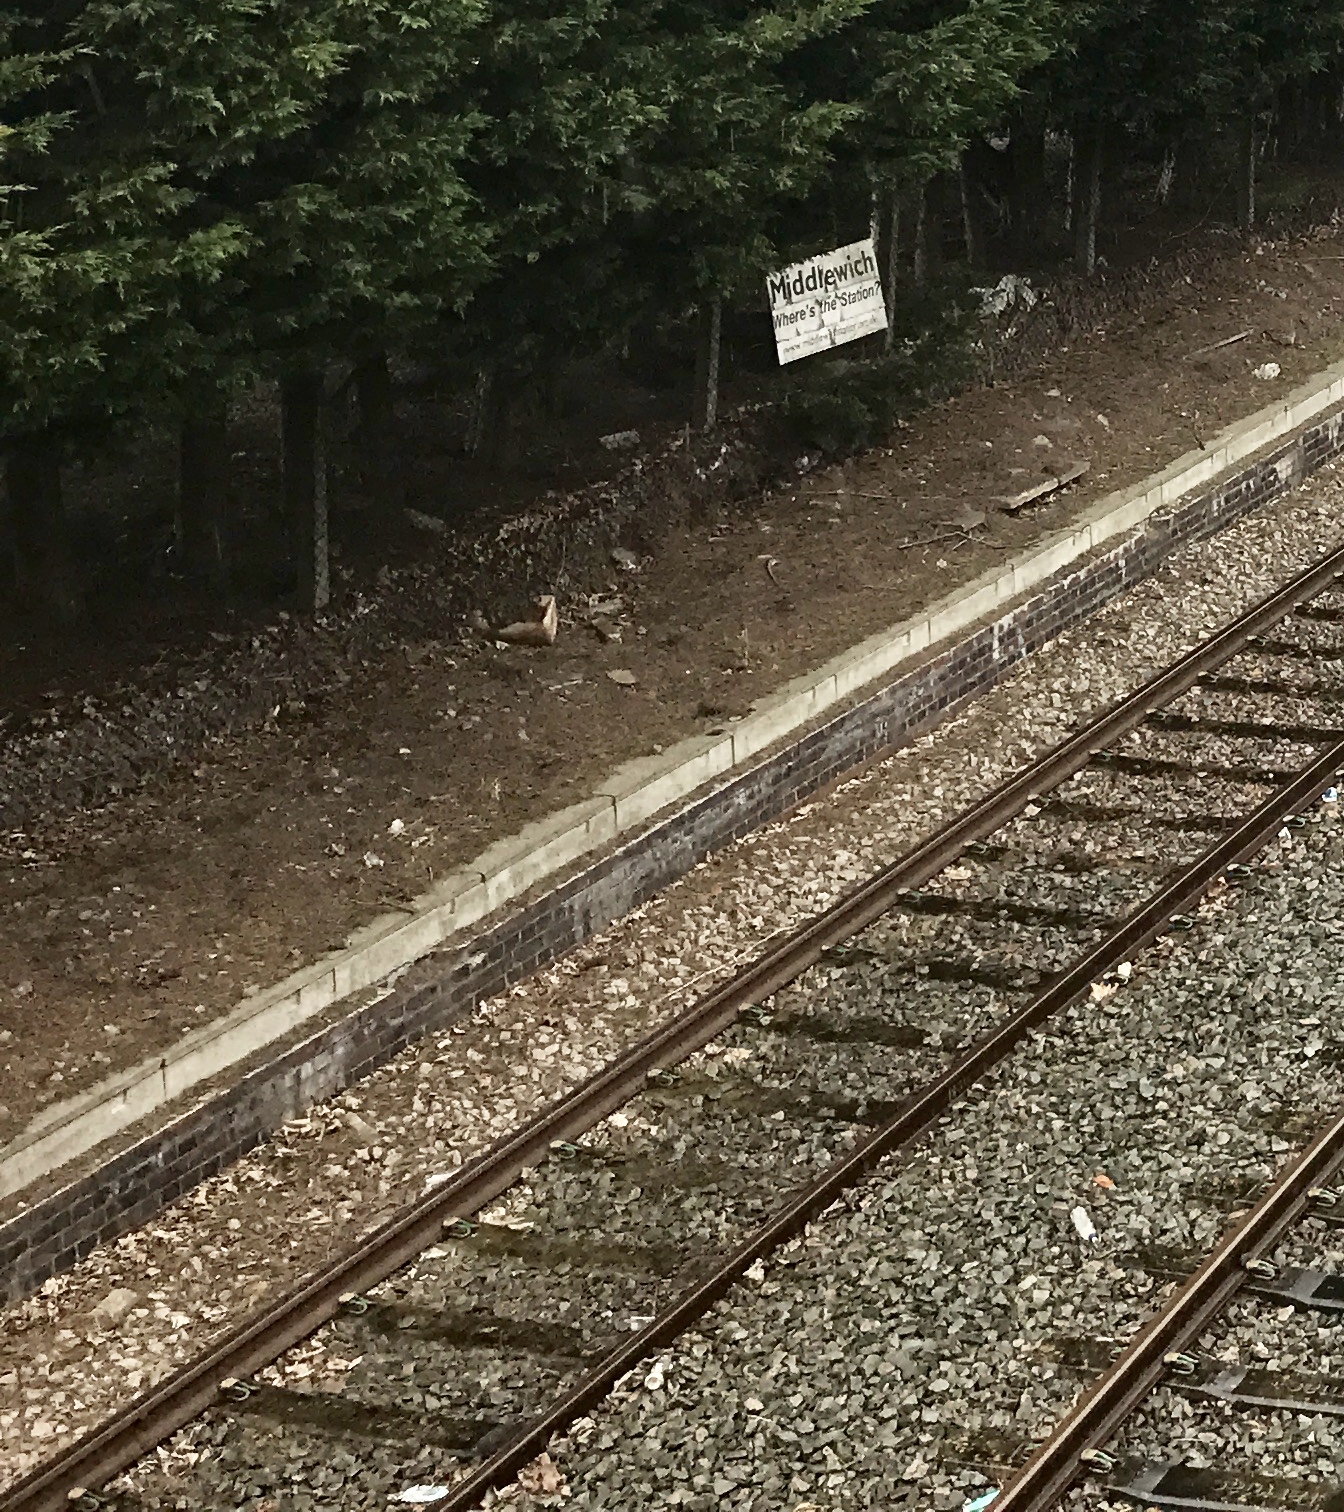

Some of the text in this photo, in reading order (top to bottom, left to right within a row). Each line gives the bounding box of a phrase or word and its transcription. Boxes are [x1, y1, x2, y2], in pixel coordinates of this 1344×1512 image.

[769, 251, 875, 304] Middlewich
[774, 281, 881, 329] Where's the Station?
